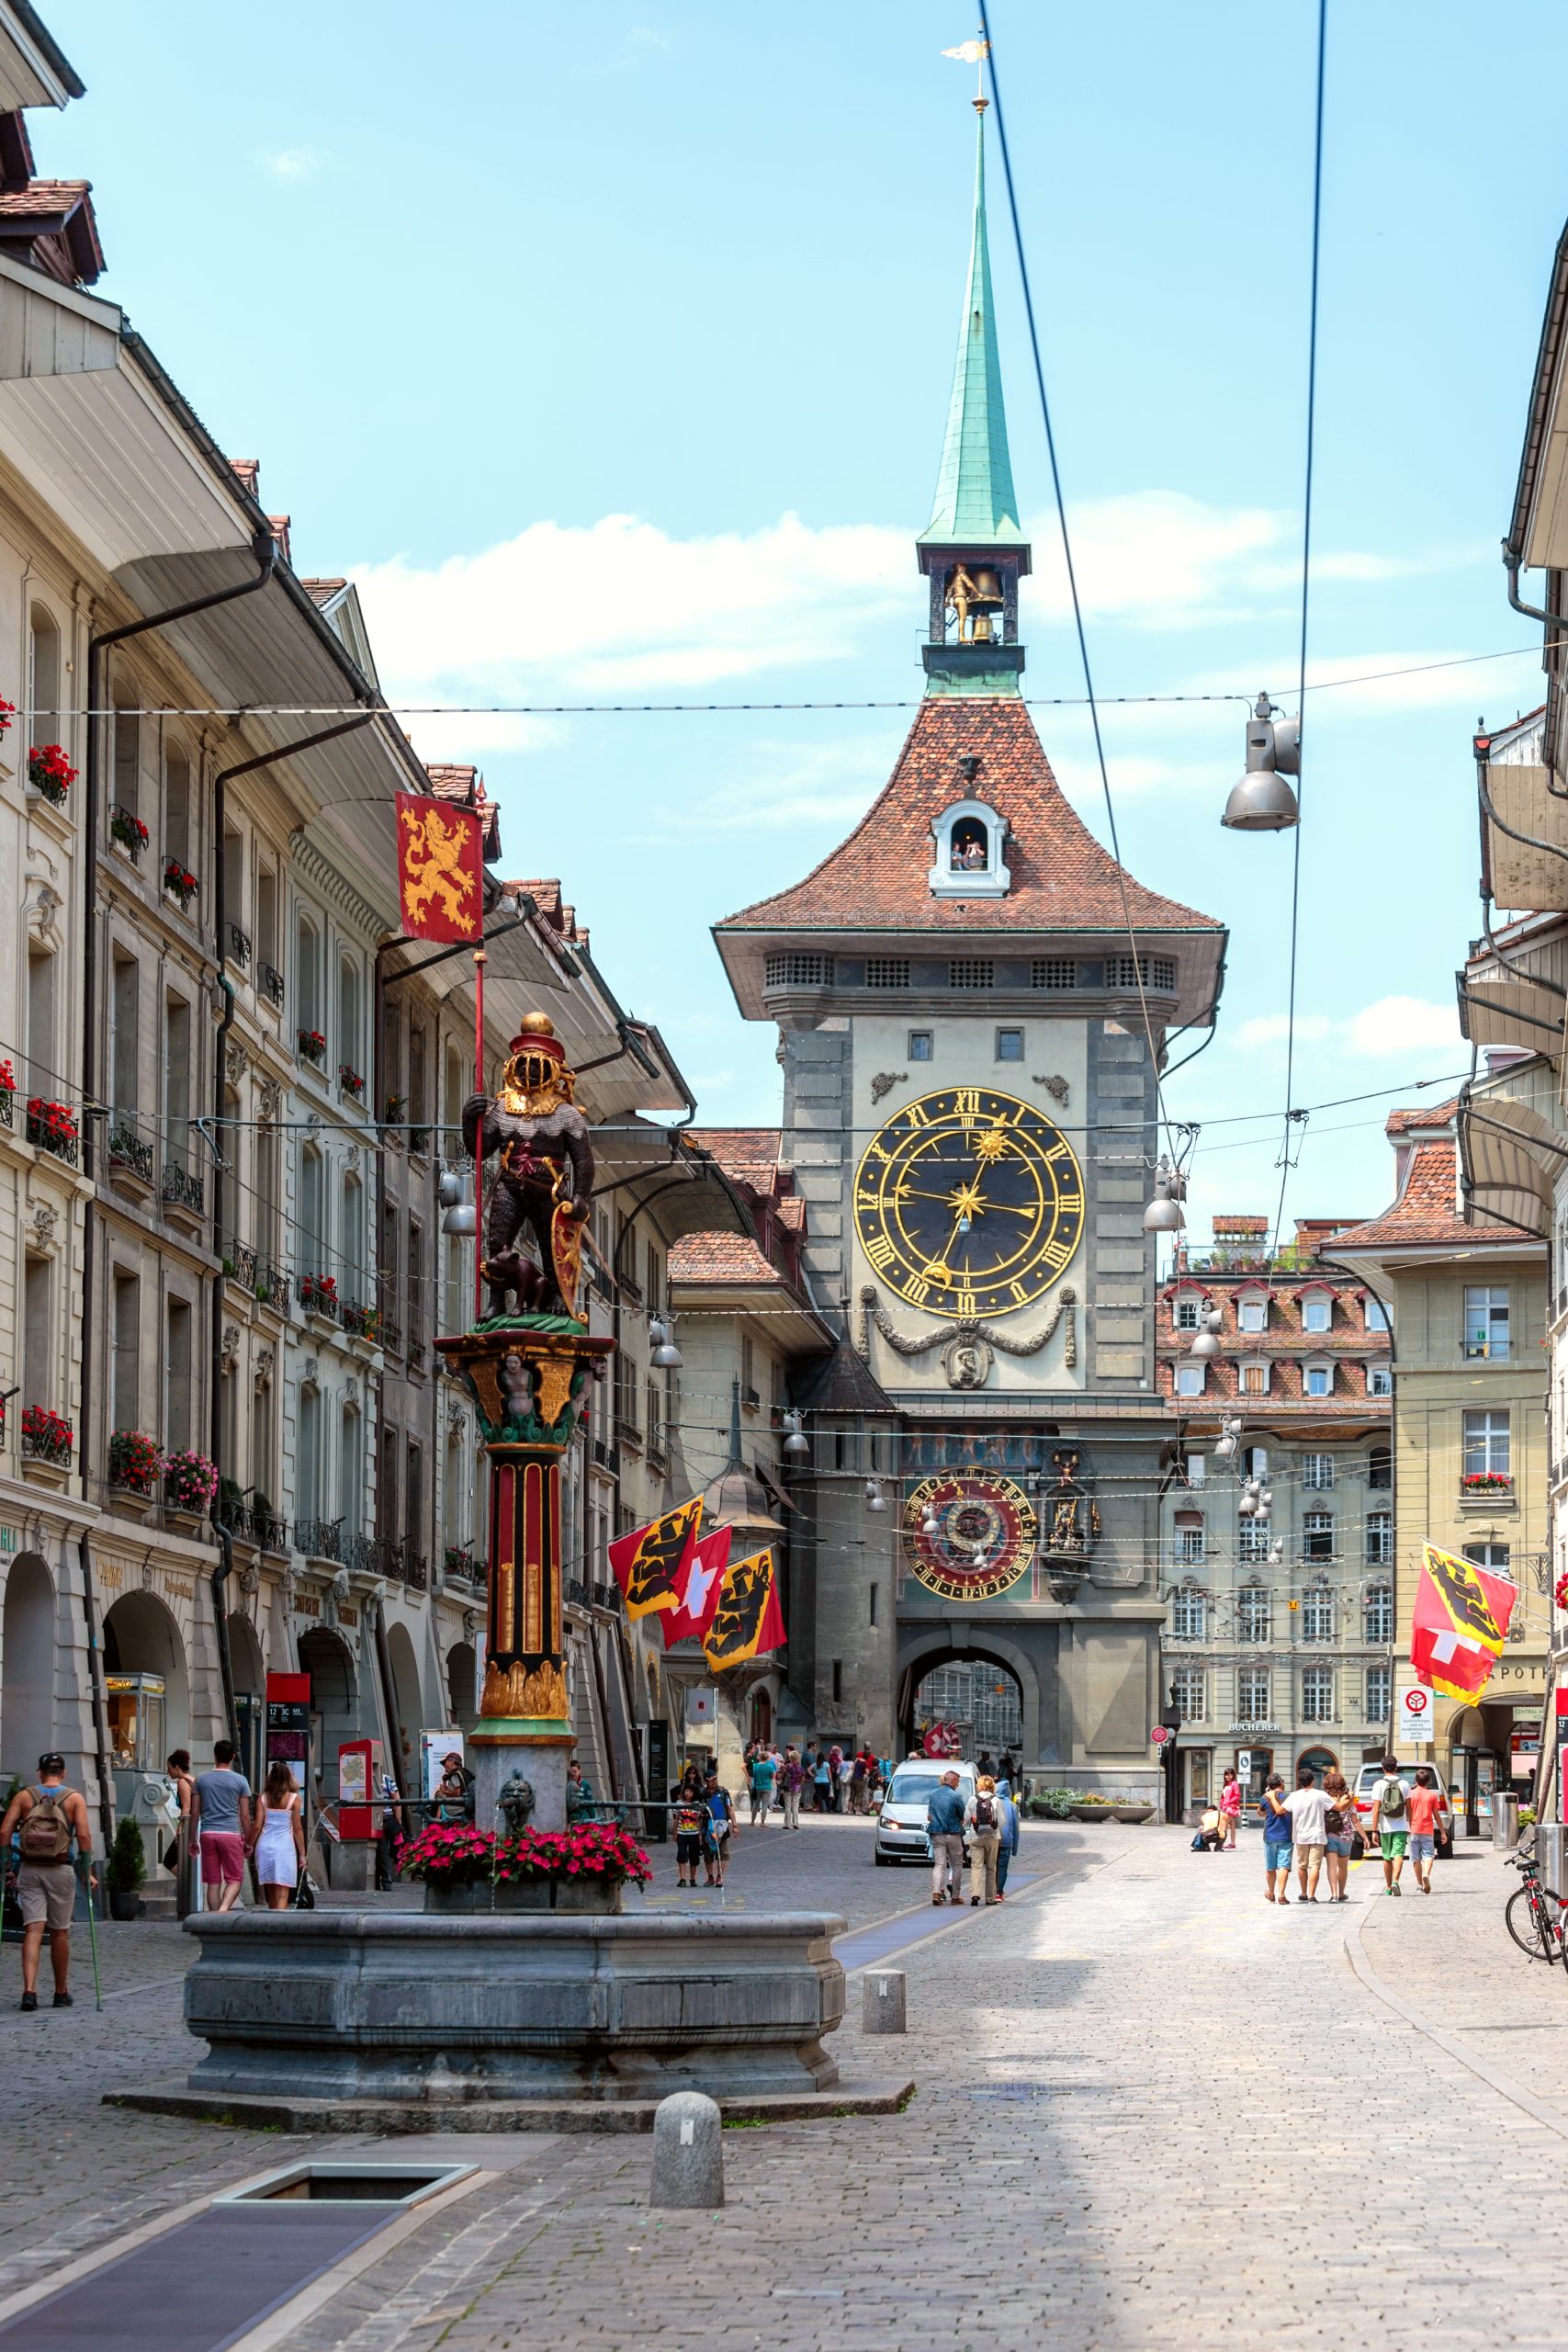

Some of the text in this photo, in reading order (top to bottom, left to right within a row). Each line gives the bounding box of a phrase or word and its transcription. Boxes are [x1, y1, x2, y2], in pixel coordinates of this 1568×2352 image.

[954, 1091, 979, 1113] XII
[907, 1104, 930, 1127] XI
[1013, 1106, 1025, 1125] I
[873, 1142, 891, 1163] X
[1046, 1142, 1066, 1159] II
[858, 1193, 879, 1211] IX
[1060, 1193, 1080, 1213] III
[1042, 1240, 1070, 1269] IIII
[1229, 1724, 1280, 1732] BUCHERER
